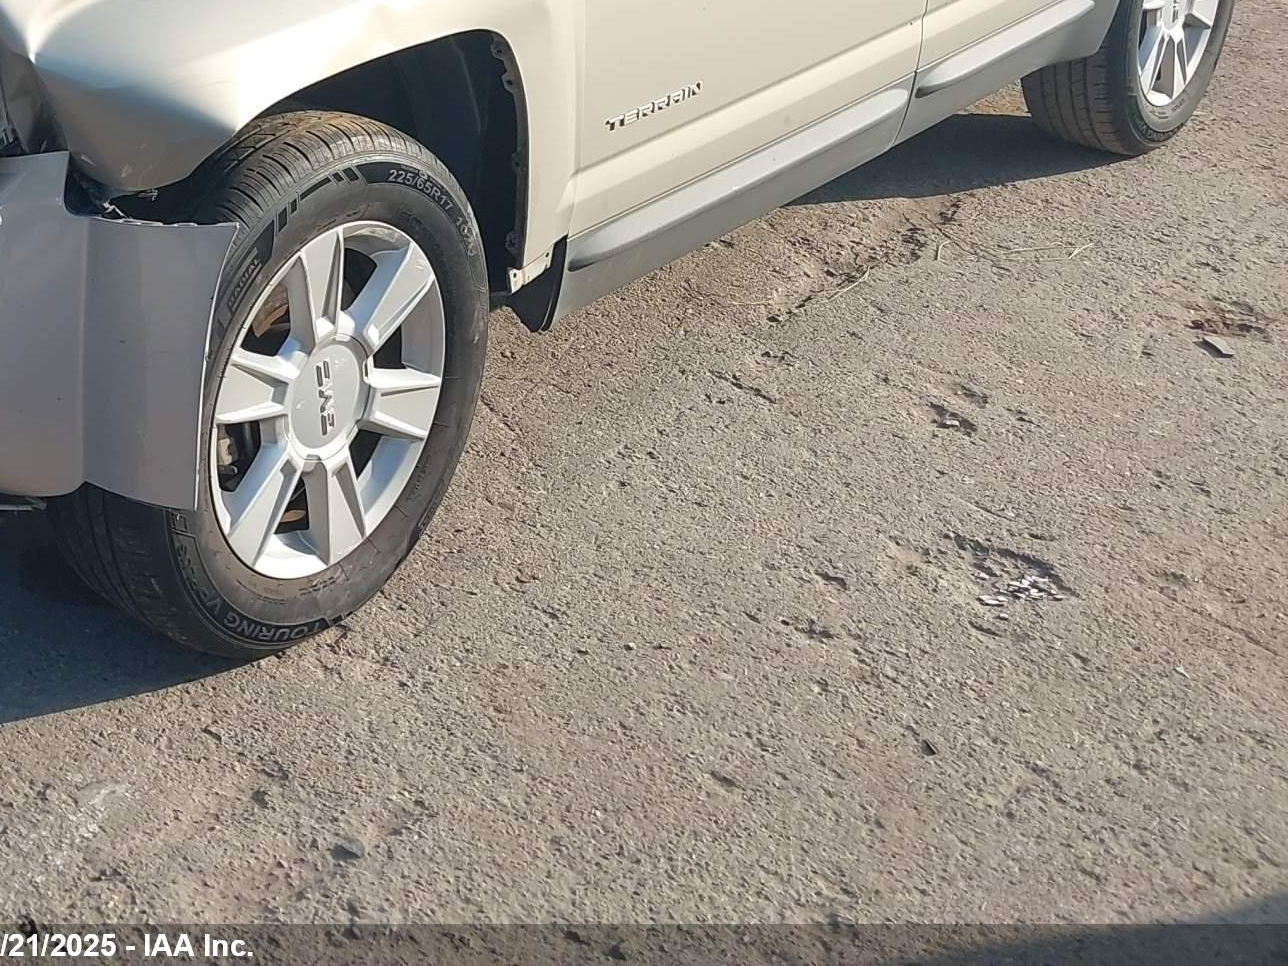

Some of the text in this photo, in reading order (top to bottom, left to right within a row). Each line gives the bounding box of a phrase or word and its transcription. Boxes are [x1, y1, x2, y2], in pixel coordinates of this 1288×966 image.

[605, 81, 703, 132] TERRAIN
[388, 169, 453, 212] 225/65R17
[315, 360, 335, 436] GMC
[223, 611, 321, 643] TOURING
